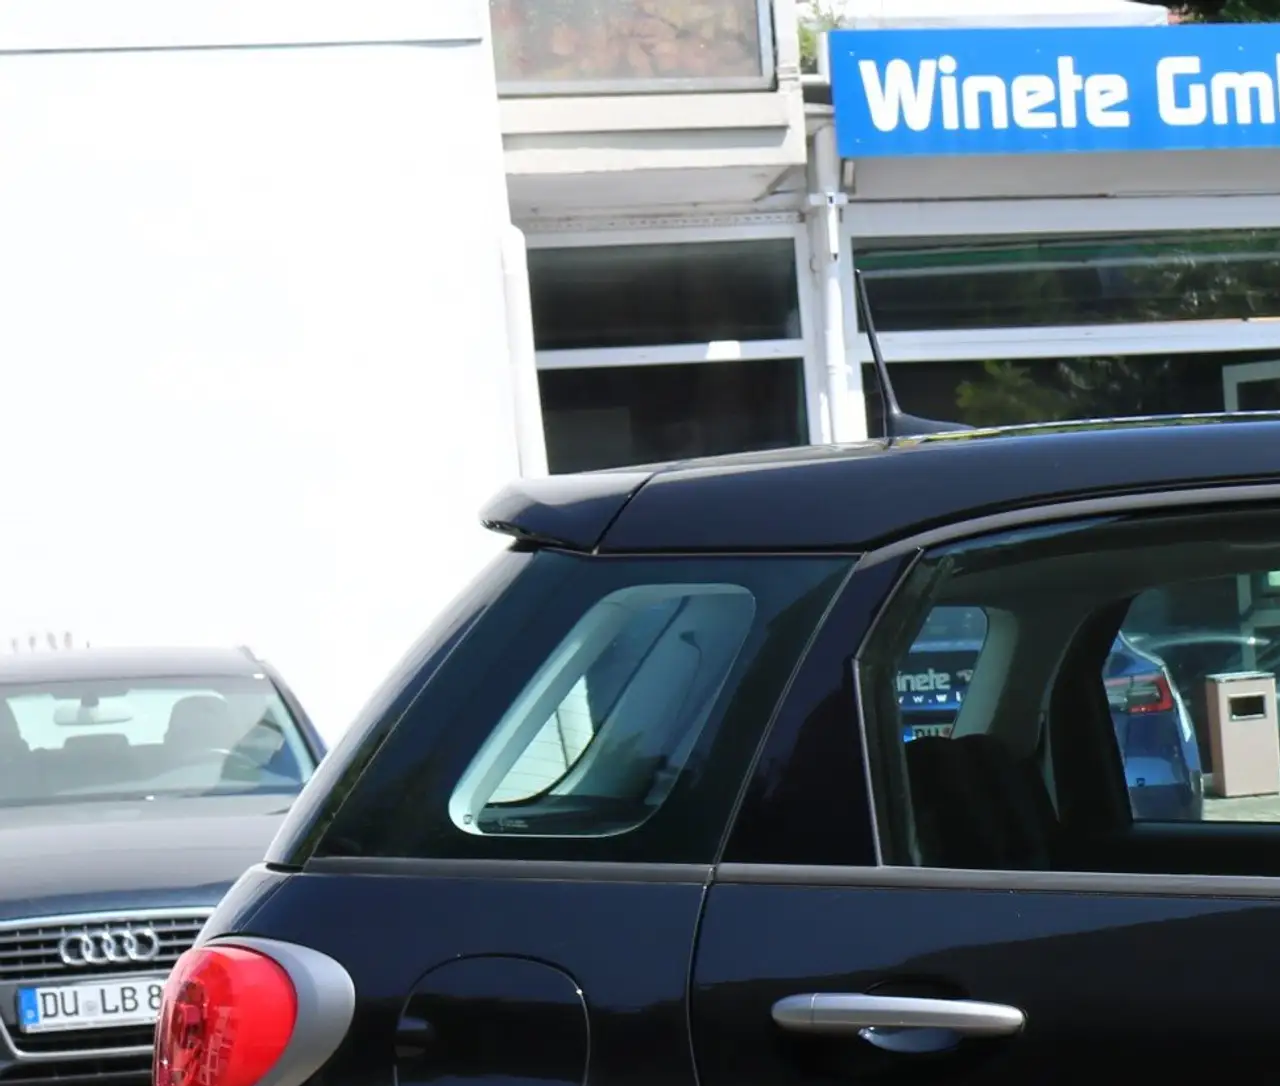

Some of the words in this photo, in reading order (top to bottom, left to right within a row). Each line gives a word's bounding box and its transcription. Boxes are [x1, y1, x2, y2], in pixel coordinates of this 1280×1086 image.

[858, 55, 1130, 132] Winete
[40, 991, 79, 1018] DU
[101, 986, 139, 1014] LB
